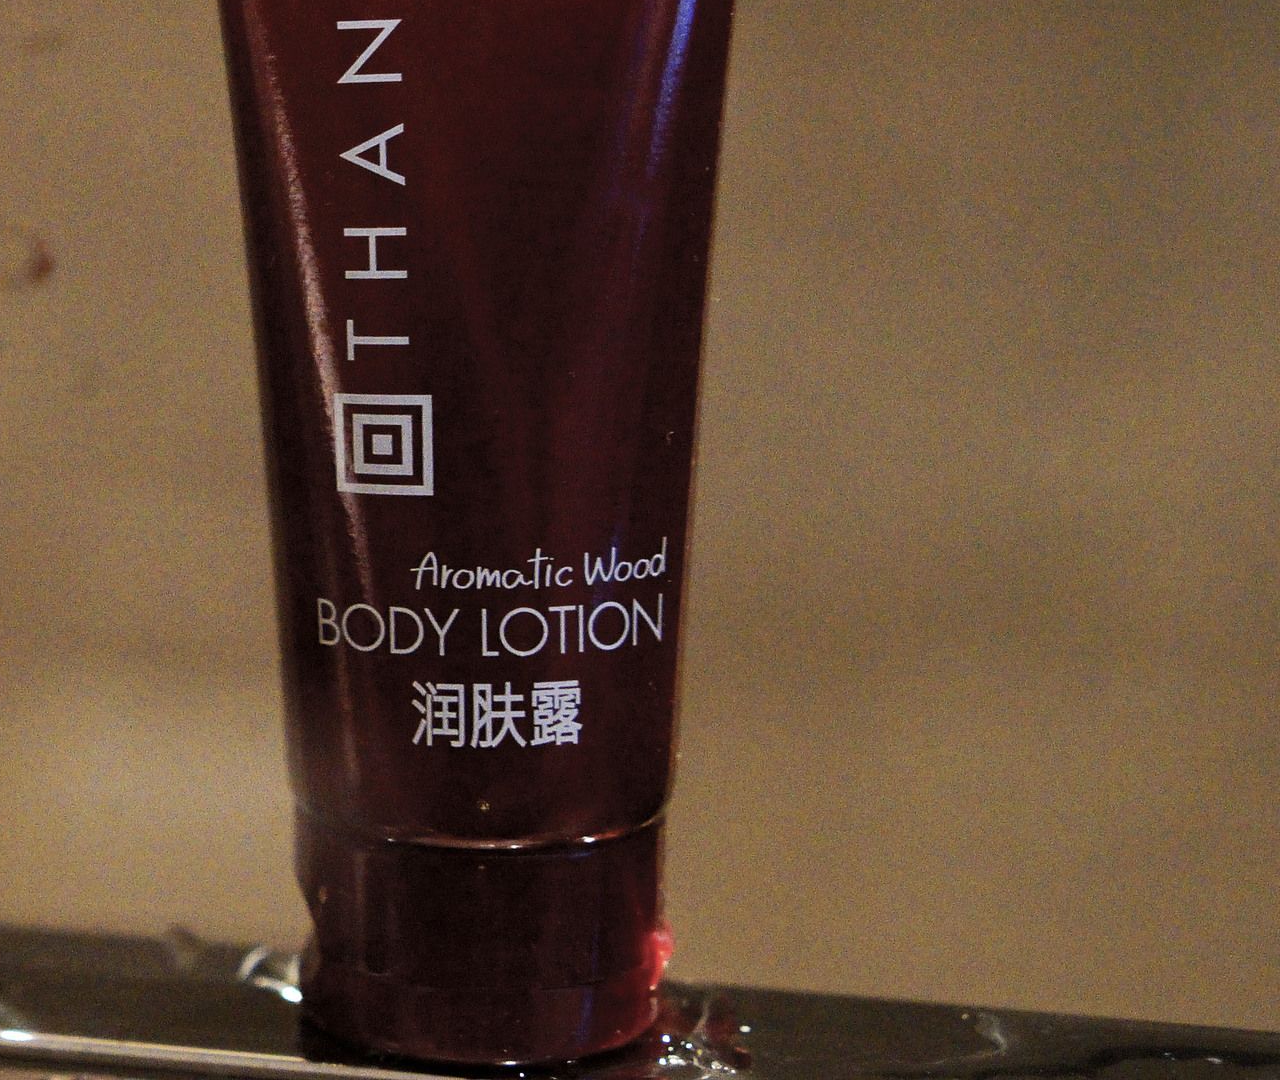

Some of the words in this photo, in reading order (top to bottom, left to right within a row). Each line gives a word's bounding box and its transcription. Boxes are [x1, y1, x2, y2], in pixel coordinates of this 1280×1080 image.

[410, 548, 574, 591] Aromatic
[583, 537, 667, 586] Wood
[316, 598, 459, 657] BODY
[480, 593, 664, 658] LOTION
[411, 680, 584, 749] 润肤露
